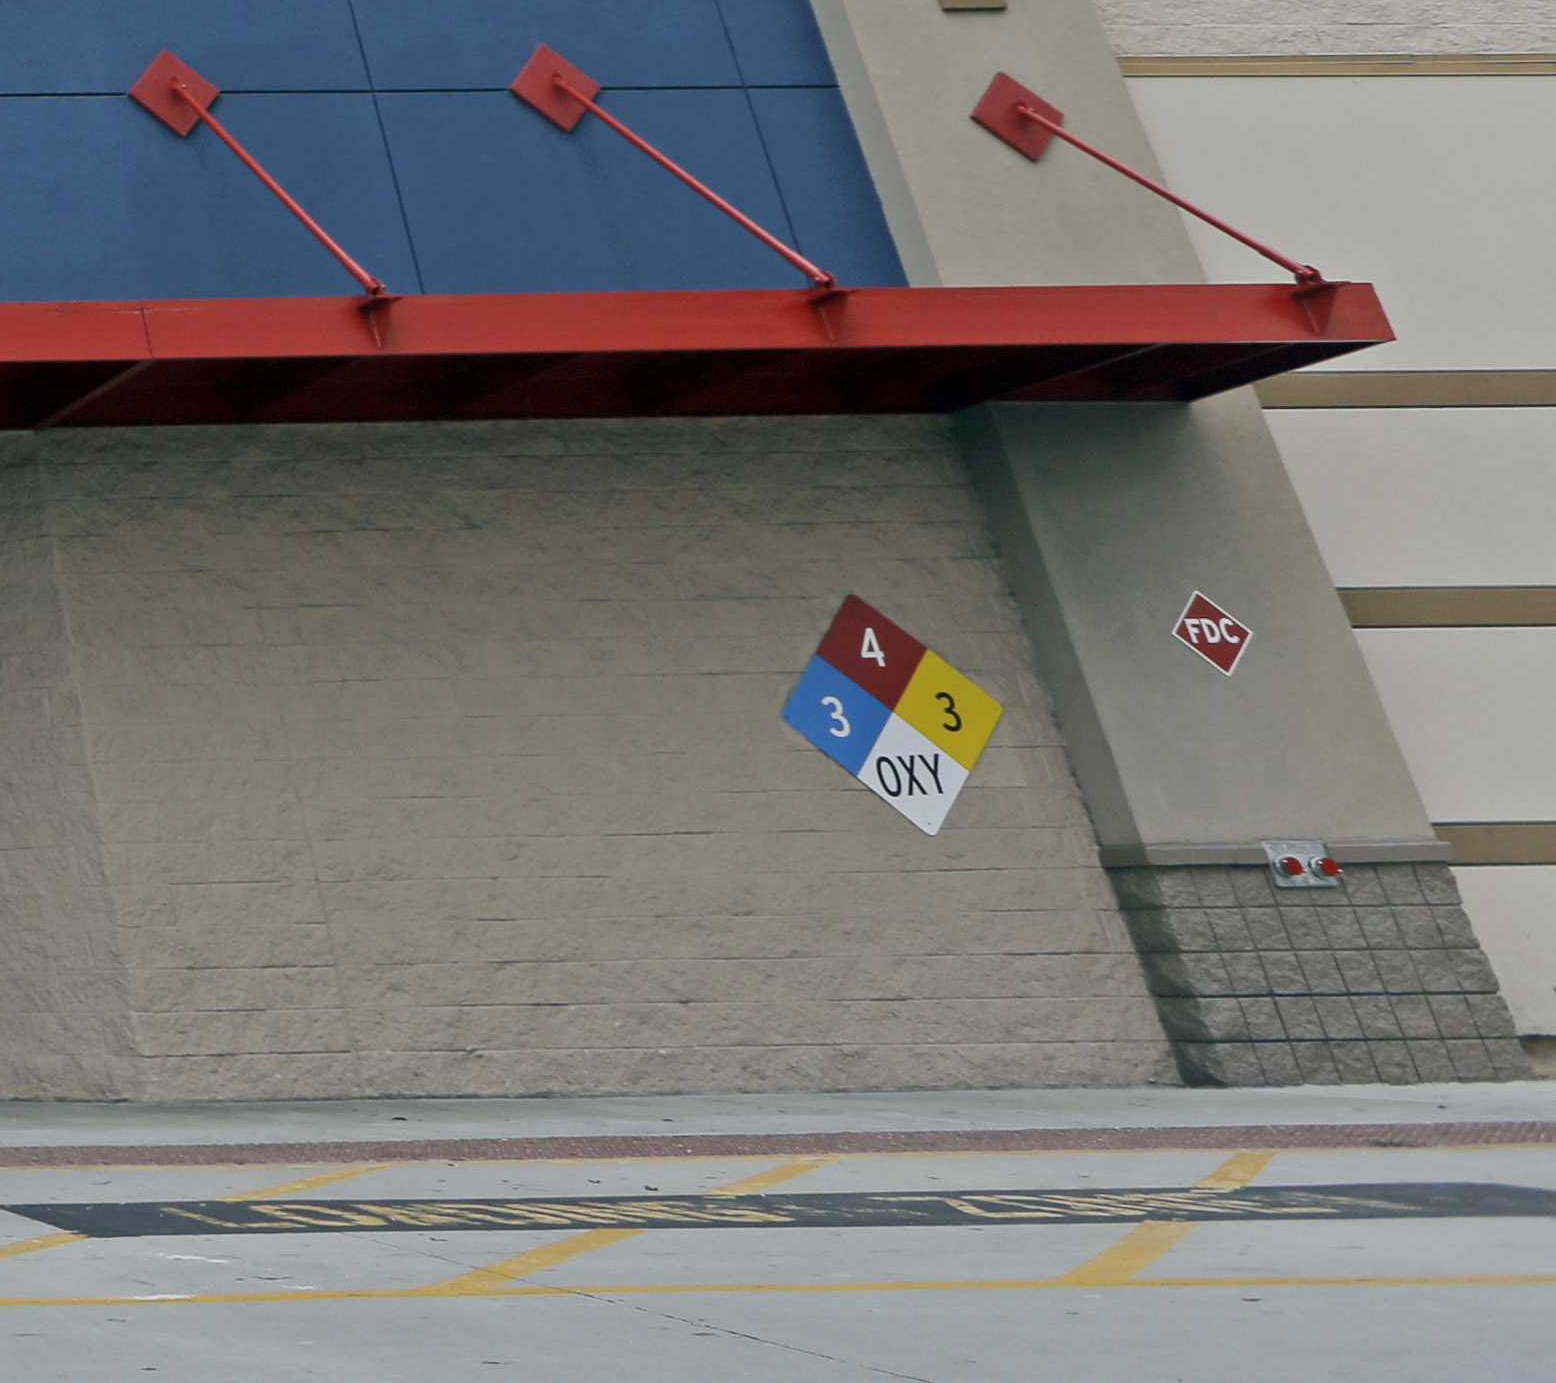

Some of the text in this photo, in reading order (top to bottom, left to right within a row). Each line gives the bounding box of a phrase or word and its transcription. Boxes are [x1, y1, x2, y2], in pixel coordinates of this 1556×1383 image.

[861, 627, 886, 667] 4
[1184, 618, 1240, 644] FDC
[821, 696, 851, 737] 3
[936, 692, 962, 732] 3
[876, 753, 944, 797] OXY
